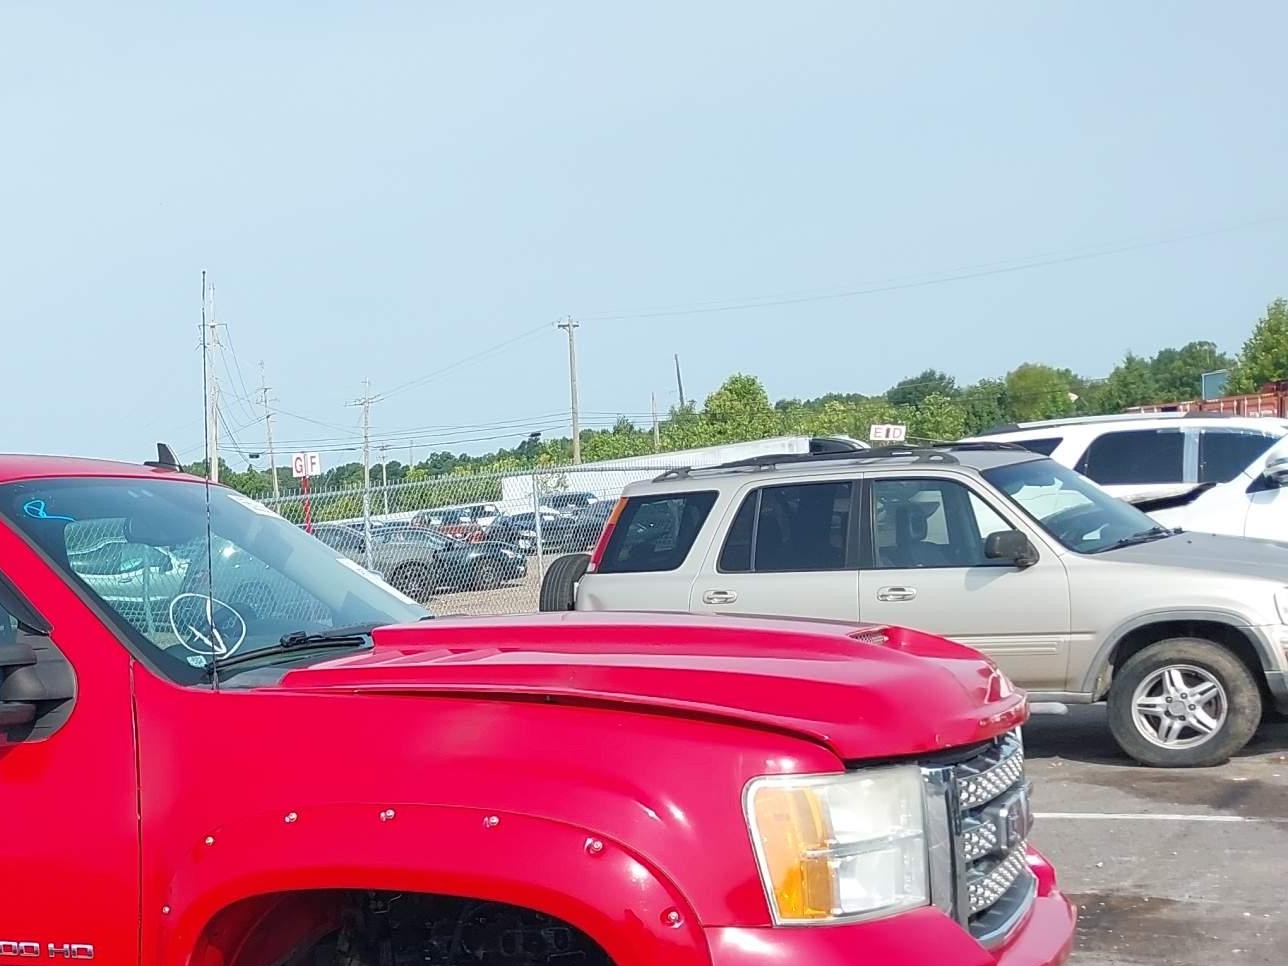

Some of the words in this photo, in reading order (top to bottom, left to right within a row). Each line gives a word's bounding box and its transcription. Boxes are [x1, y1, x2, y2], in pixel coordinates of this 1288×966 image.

[294, 456, 303, 474] G
[310, 455, 317, 473] F
[47, 942, 94, 960] HD
